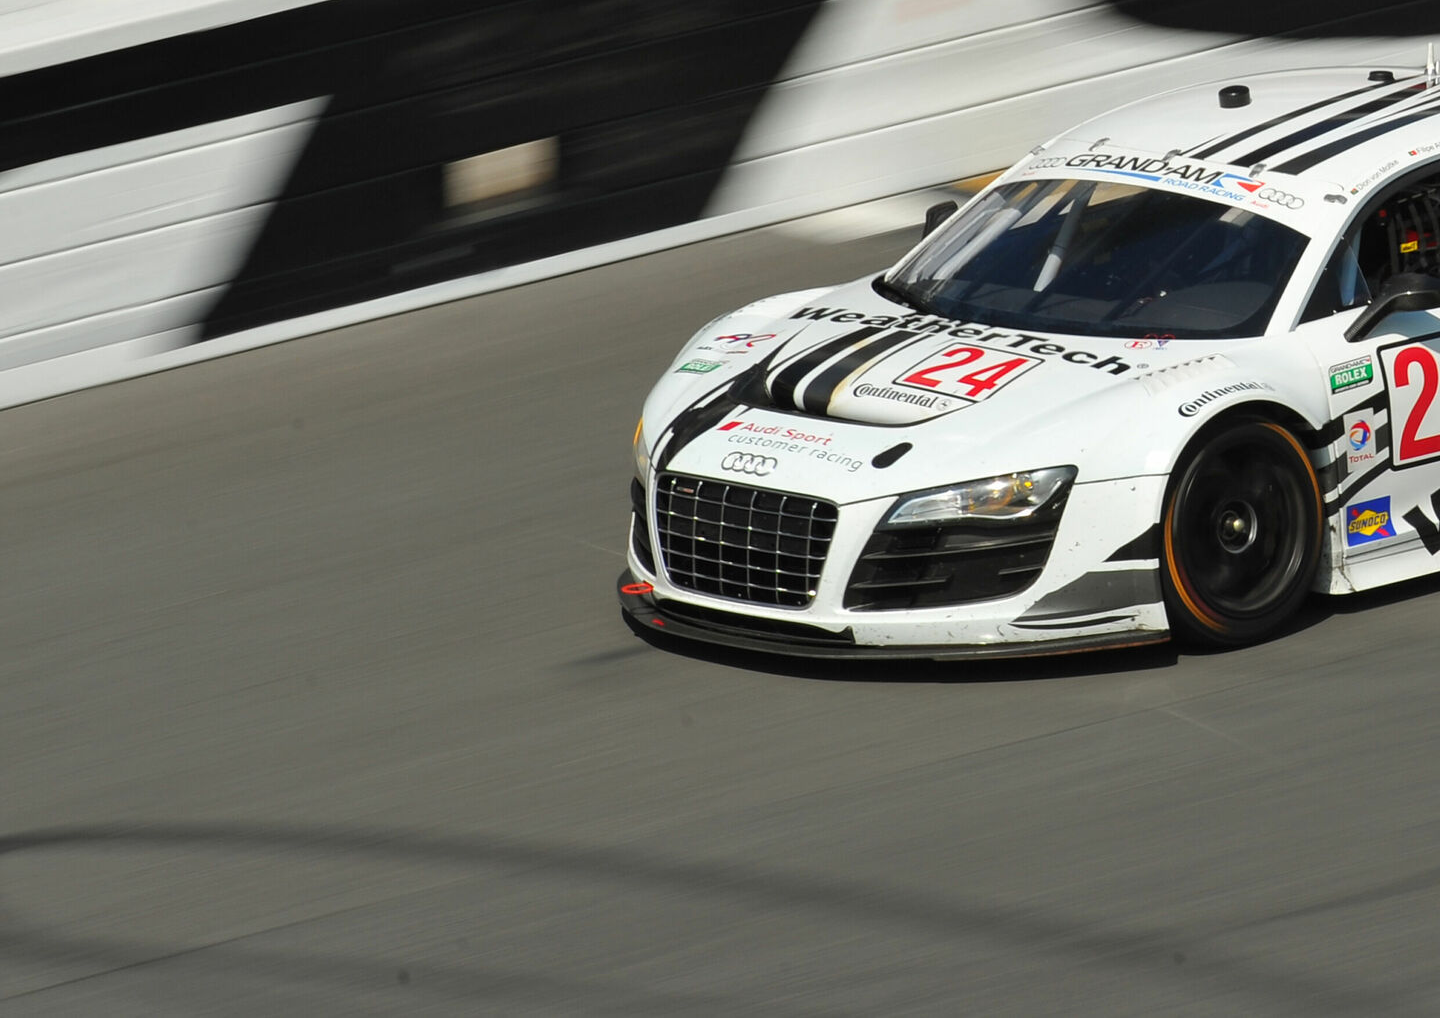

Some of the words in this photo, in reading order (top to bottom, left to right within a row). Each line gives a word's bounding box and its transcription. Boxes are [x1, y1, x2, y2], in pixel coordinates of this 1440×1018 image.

[1162, 177, 1200, 193] ROAD
[1199, 185, 1244, 201] RACING
[789, 307, 1131, 375] WeatherTech
[902, 348, 1029, 397] 24
[1335, 366, 1367, 386] ROLEX
[853, 383, 936, 409] Continental
[1178, 382, 1261, 417] Continental
[741, 423, 779, 435] Audi
[781, 428, 832, 446] Sport
[727, 433, 806, 454] customer
[809, 447, 863, 472] racing
[1349, 453, 1374, 463] TOTAL
[1349, 510, 1388, 533] SUNOCO
